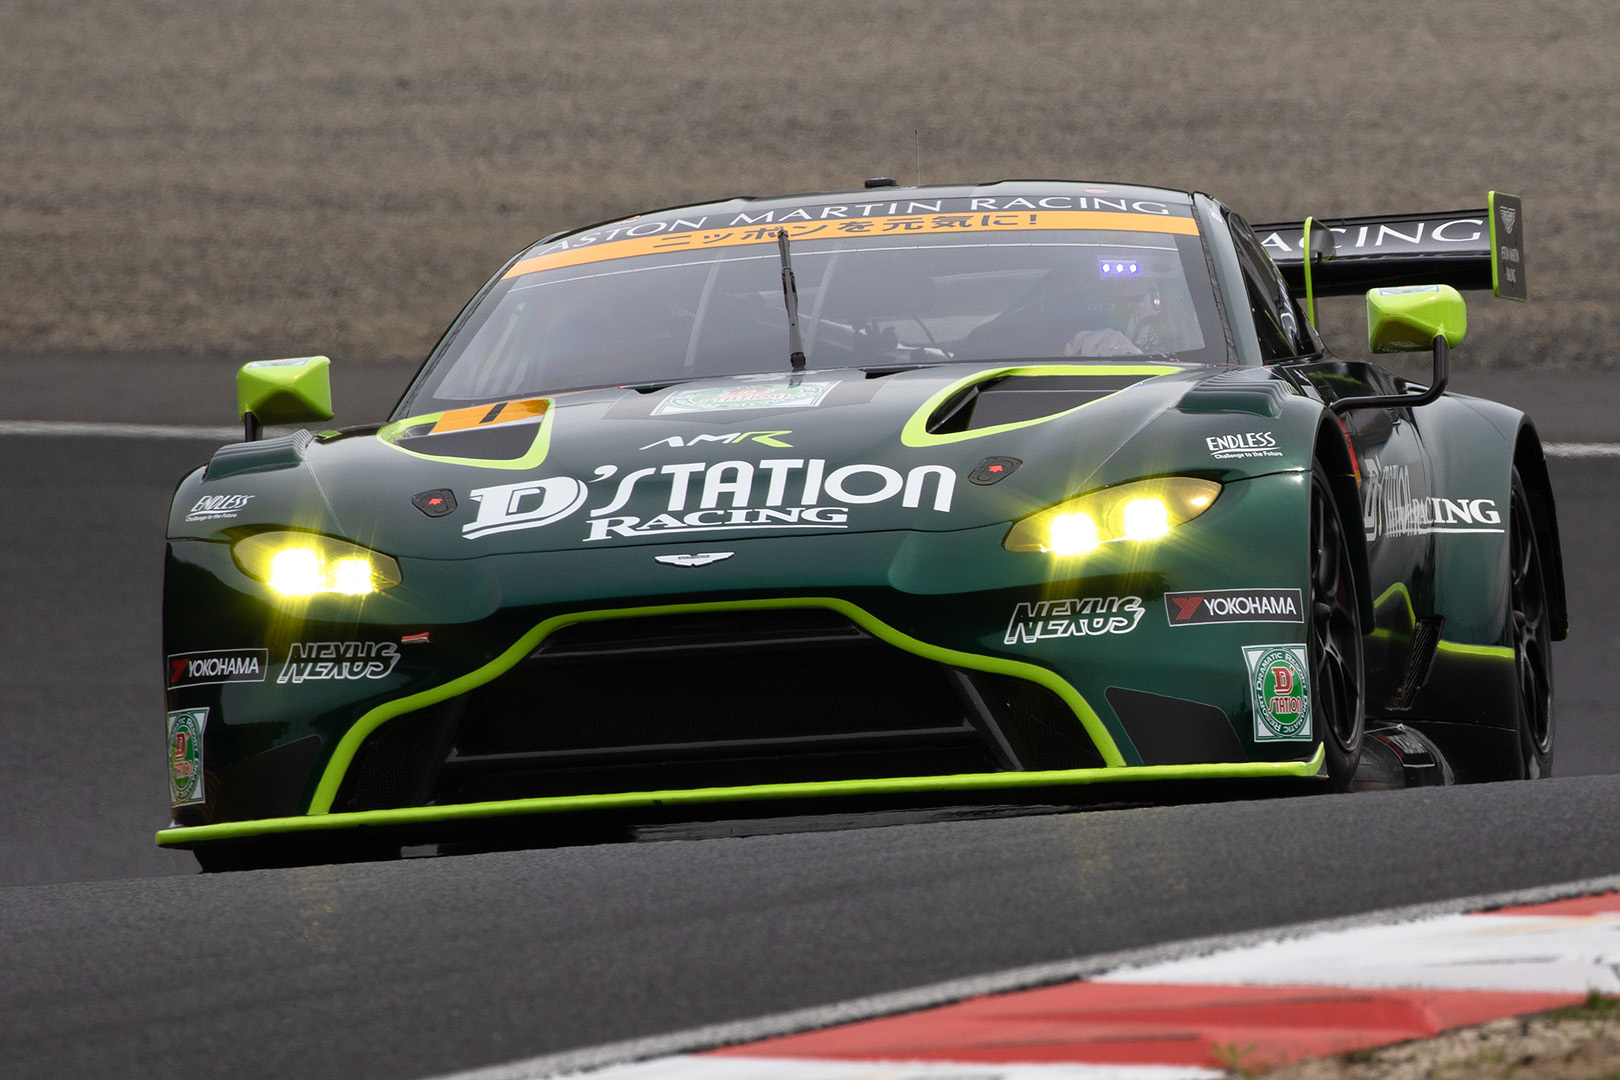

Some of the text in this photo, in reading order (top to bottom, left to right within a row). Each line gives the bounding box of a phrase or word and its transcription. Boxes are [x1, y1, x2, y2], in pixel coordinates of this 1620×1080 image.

[539, 196, 1169, 256] ASTON MARTIN RACING
[639, 430, 794, 450] AMR
[1205, 431, 1277, 451] ENDLESS
[190, 494, 255, 512] ENDLESS
[582, 507, 849, 542] RACING
[1203, 596, 1297, 616] YOKOHAMA
[1004, 596, 1145, 645] NEXUS
[188, 657, 260, 678] YOKOHAMA
[277, 642, 401, 684] NEXUS
[1256, 652, 1283, 691] DRAMATIC
[1268, 695, 1304, 715] STATION
